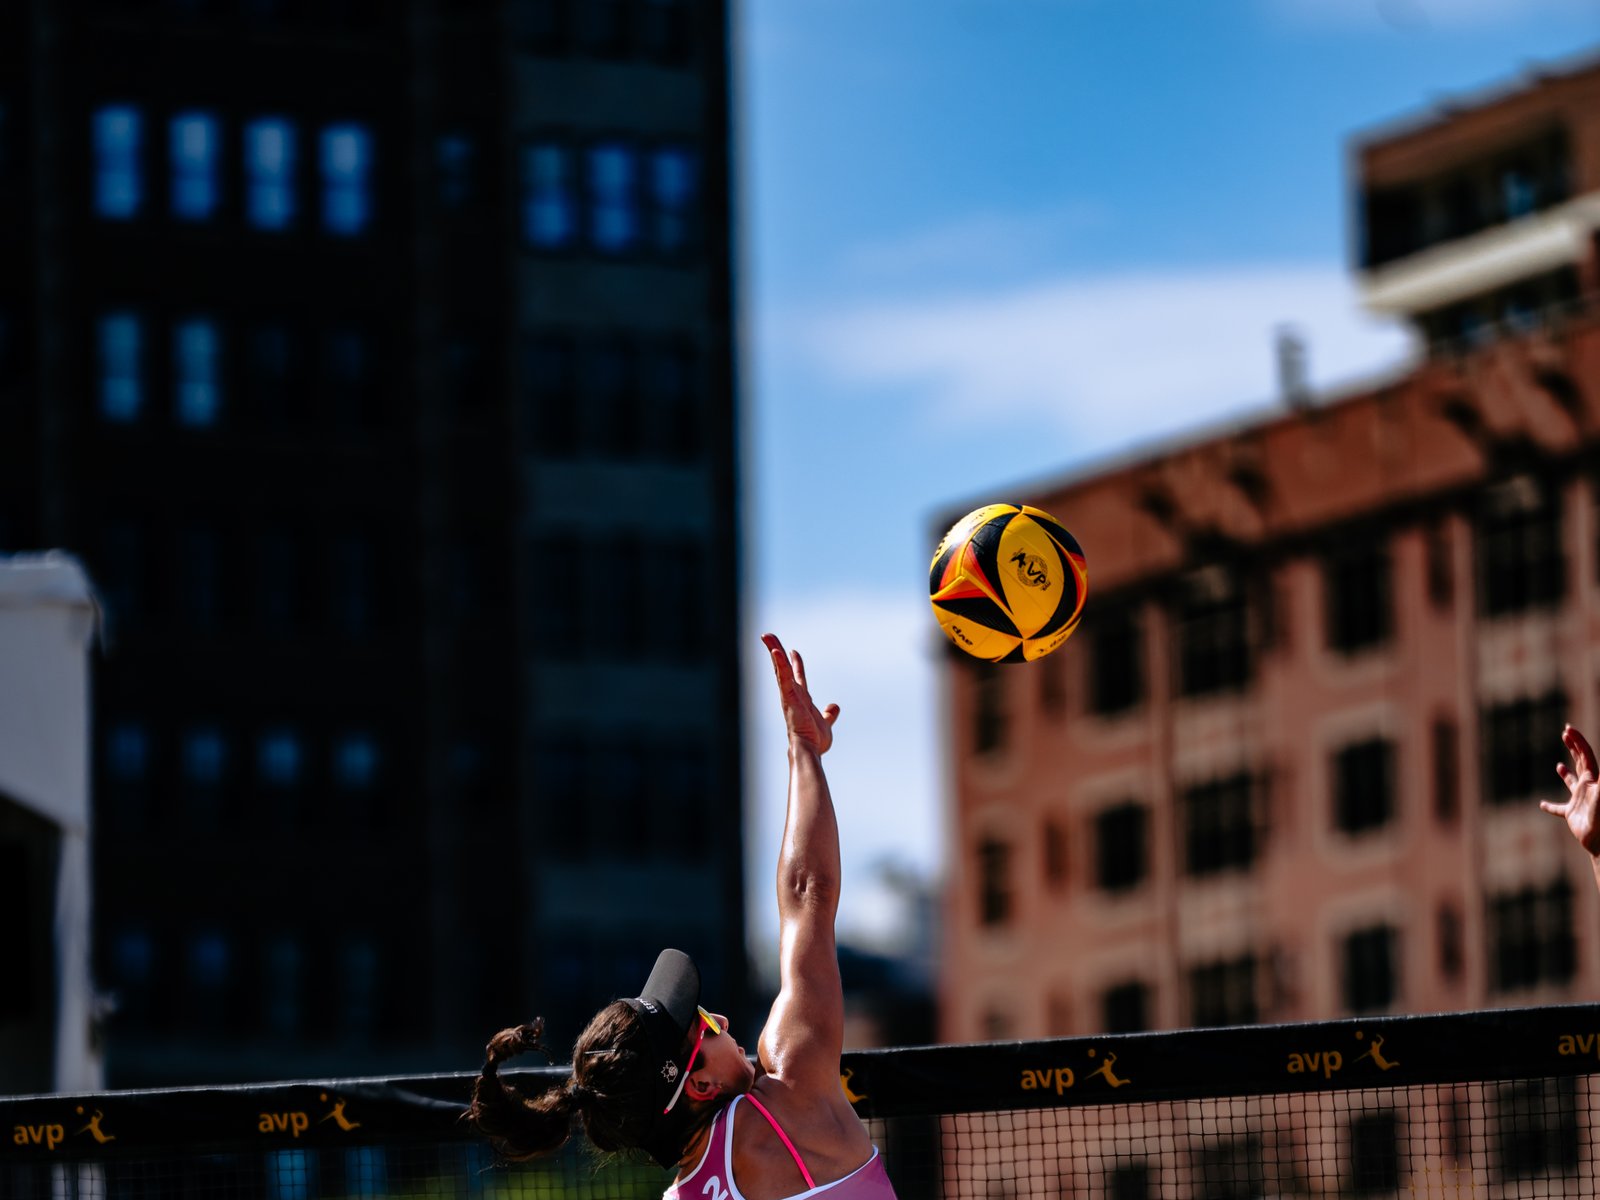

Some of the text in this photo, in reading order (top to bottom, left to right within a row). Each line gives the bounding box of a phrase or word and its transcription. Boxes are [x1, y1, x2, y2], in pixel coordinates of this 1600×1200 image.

[1558, 1033, 1600, 1060] av
[1286, 1051, 1342, 1079] avp
[1020, 1067, 1075, 1096] avp
[13, 1123, 64, 1150] avp
[258, 1111, 309, 1138] avp
